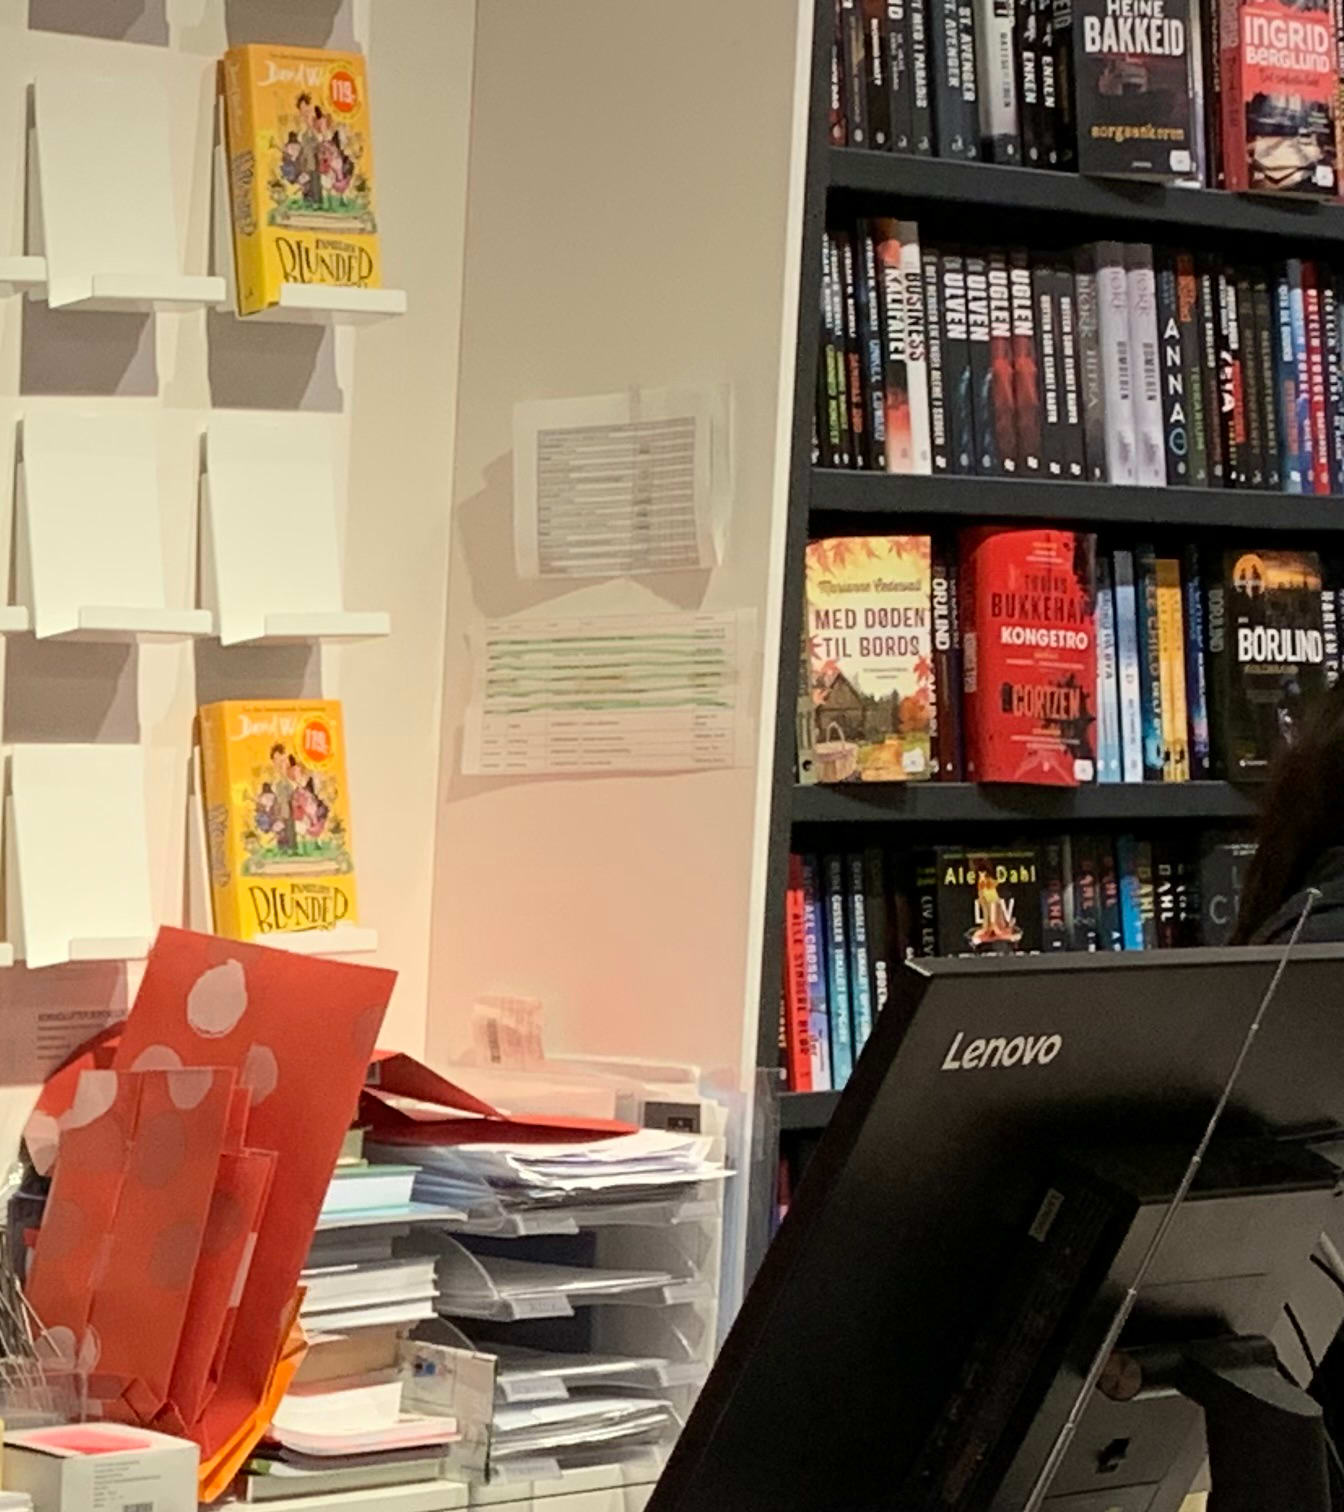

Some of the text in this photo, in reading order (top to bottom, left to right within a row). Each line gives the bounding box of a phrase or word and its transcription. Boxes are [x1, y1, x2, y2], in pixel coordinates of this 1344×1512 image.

[1084, 15, 1185, 56] BAKKEID
[1244, 15, 1329, 49] INGRID
[944, 272, 967, 340] ULVEN
[967, 274, 990, 341] ULVEN
[989, 270, 1011, 337] UGLEN
[1011, 268, 1034, 337] UGLEN
[1164, 318, 1186, 424] ANNA
[815, 607, 925, 630] MED DØDEN
[1001, 625, 1088, 650] KONGETRO
[823, 636, 920, 658] TIL BORDS
[944, 865, 1036, 885] Alex Dahl
[942, 1032, 1062, 1071] Lenovo
